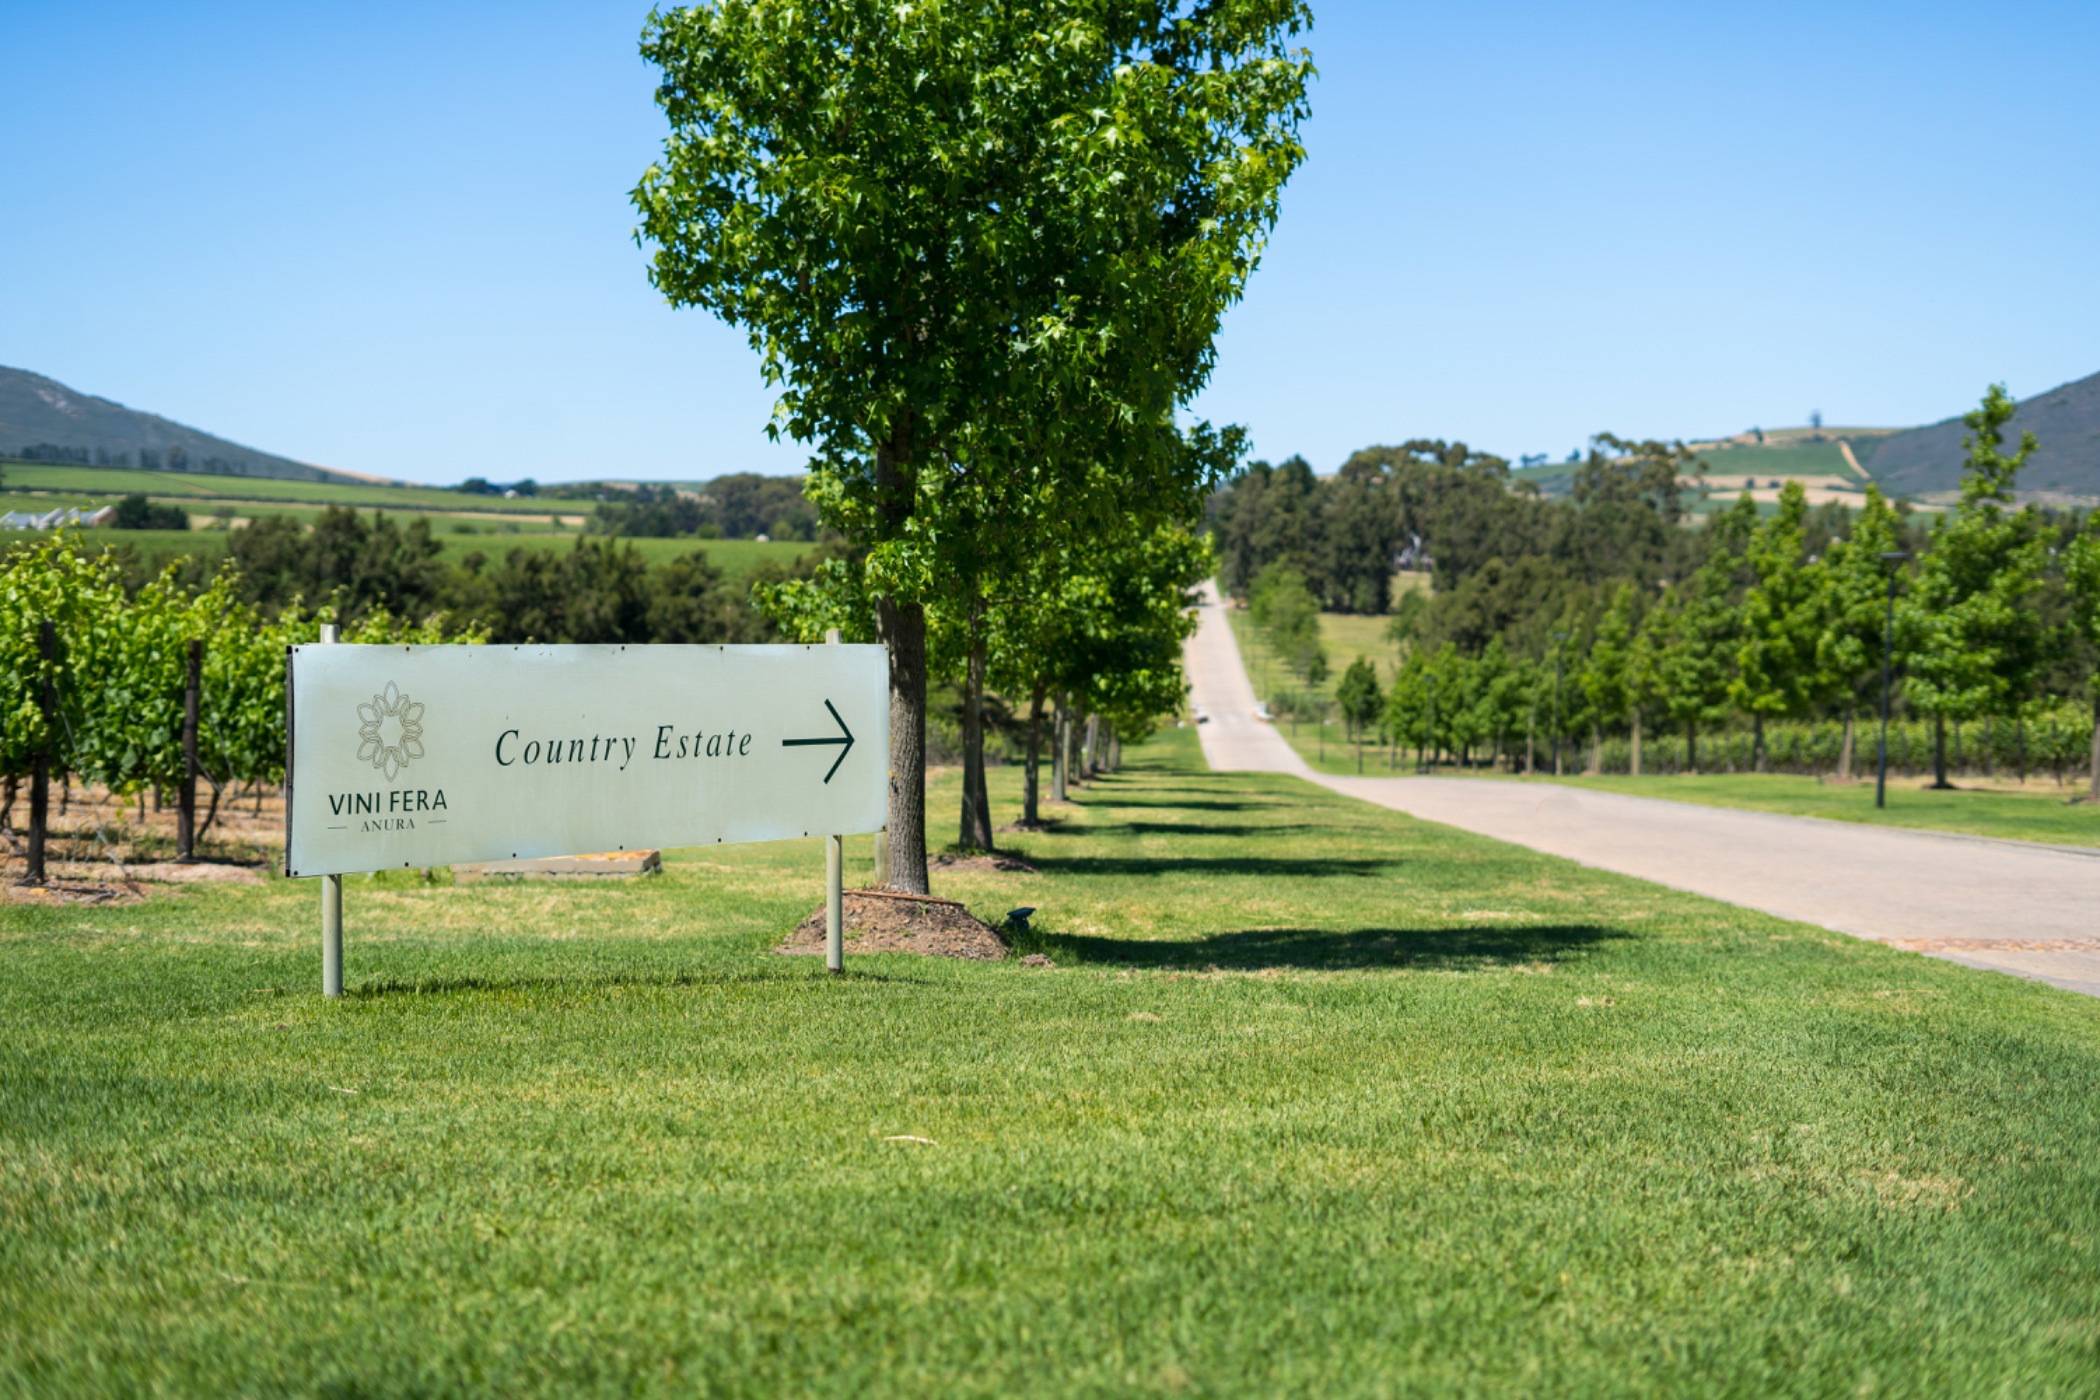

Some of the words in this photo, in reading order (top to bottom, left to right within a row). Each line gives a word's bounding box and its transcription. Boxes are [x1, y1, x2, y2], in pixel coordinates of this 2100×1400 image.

[495, 729, 636, 771] Country
[653, 725, 752, 759] Estate
[361, 818, 415, 832] ANURA
